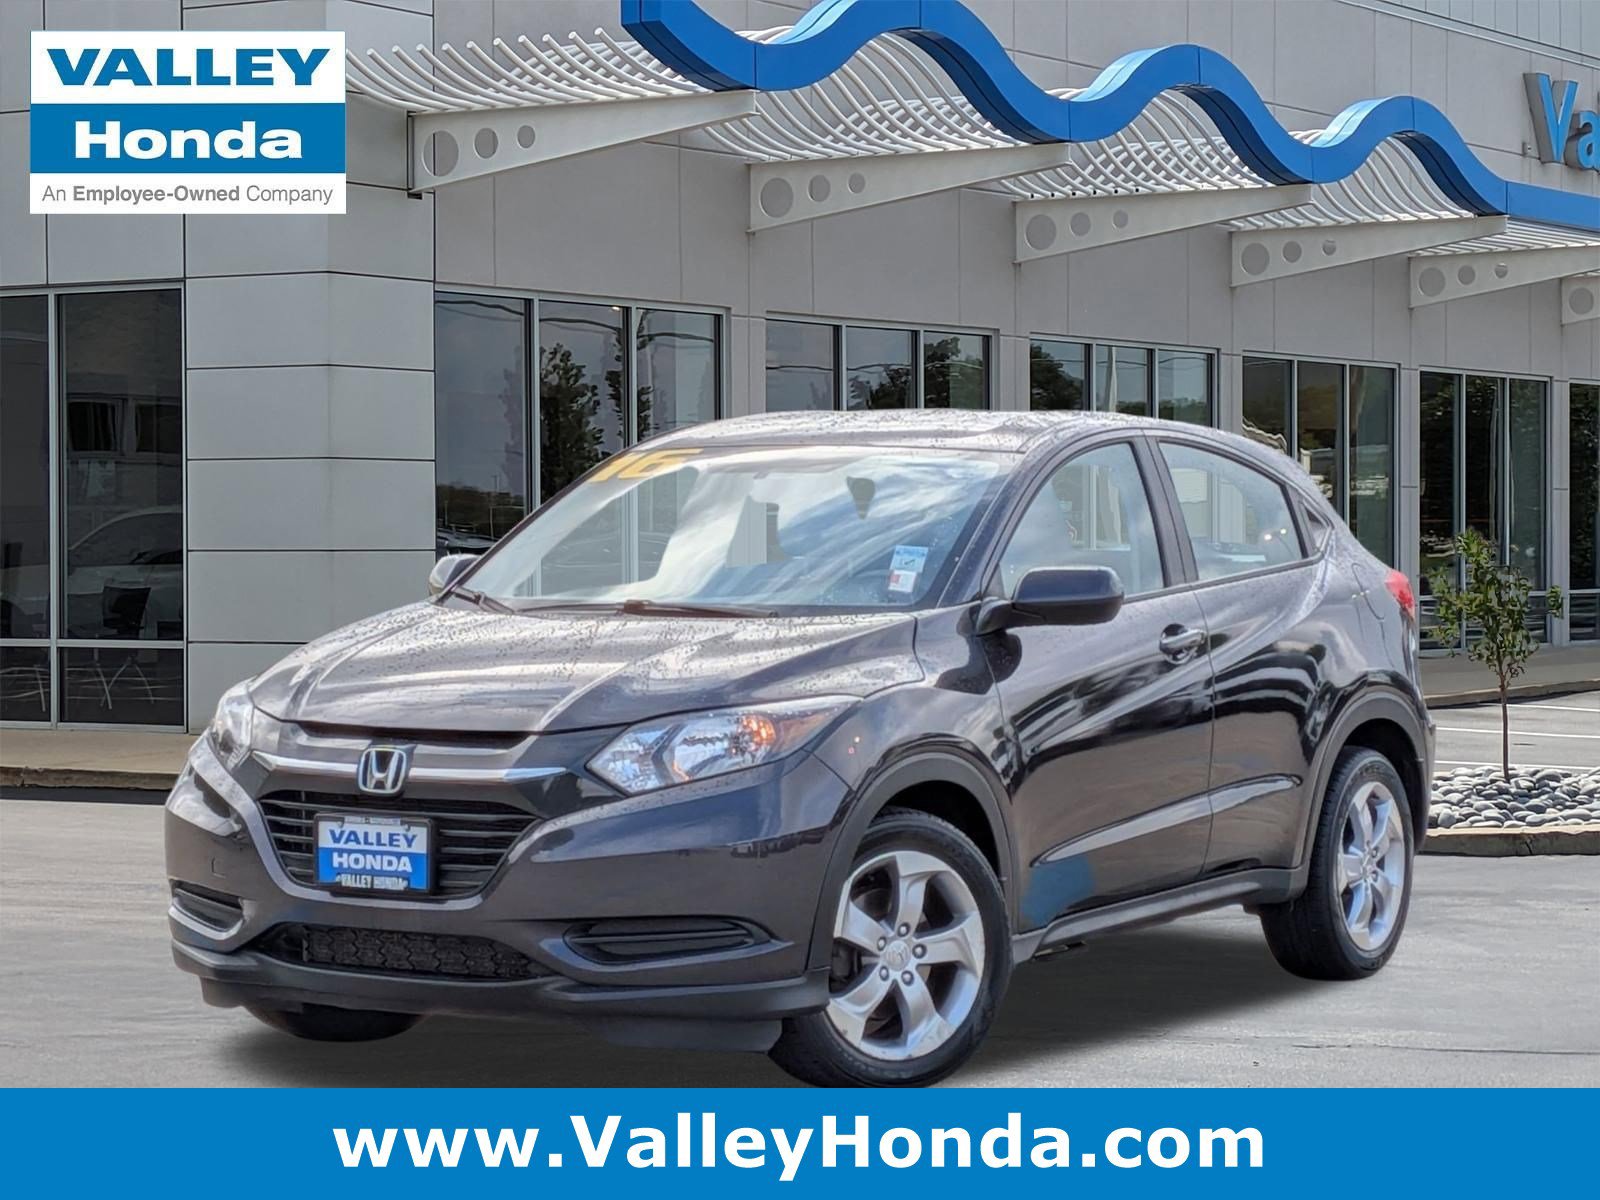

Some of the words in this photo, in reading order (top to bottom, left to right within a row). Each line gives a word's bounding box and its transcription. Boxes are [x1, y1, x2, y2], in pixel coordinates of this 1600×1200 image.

[591, 448, 704, 482] 16
[329, 829, 417, 848] VALLEY
[332, 852, 412, 872] HONDA
